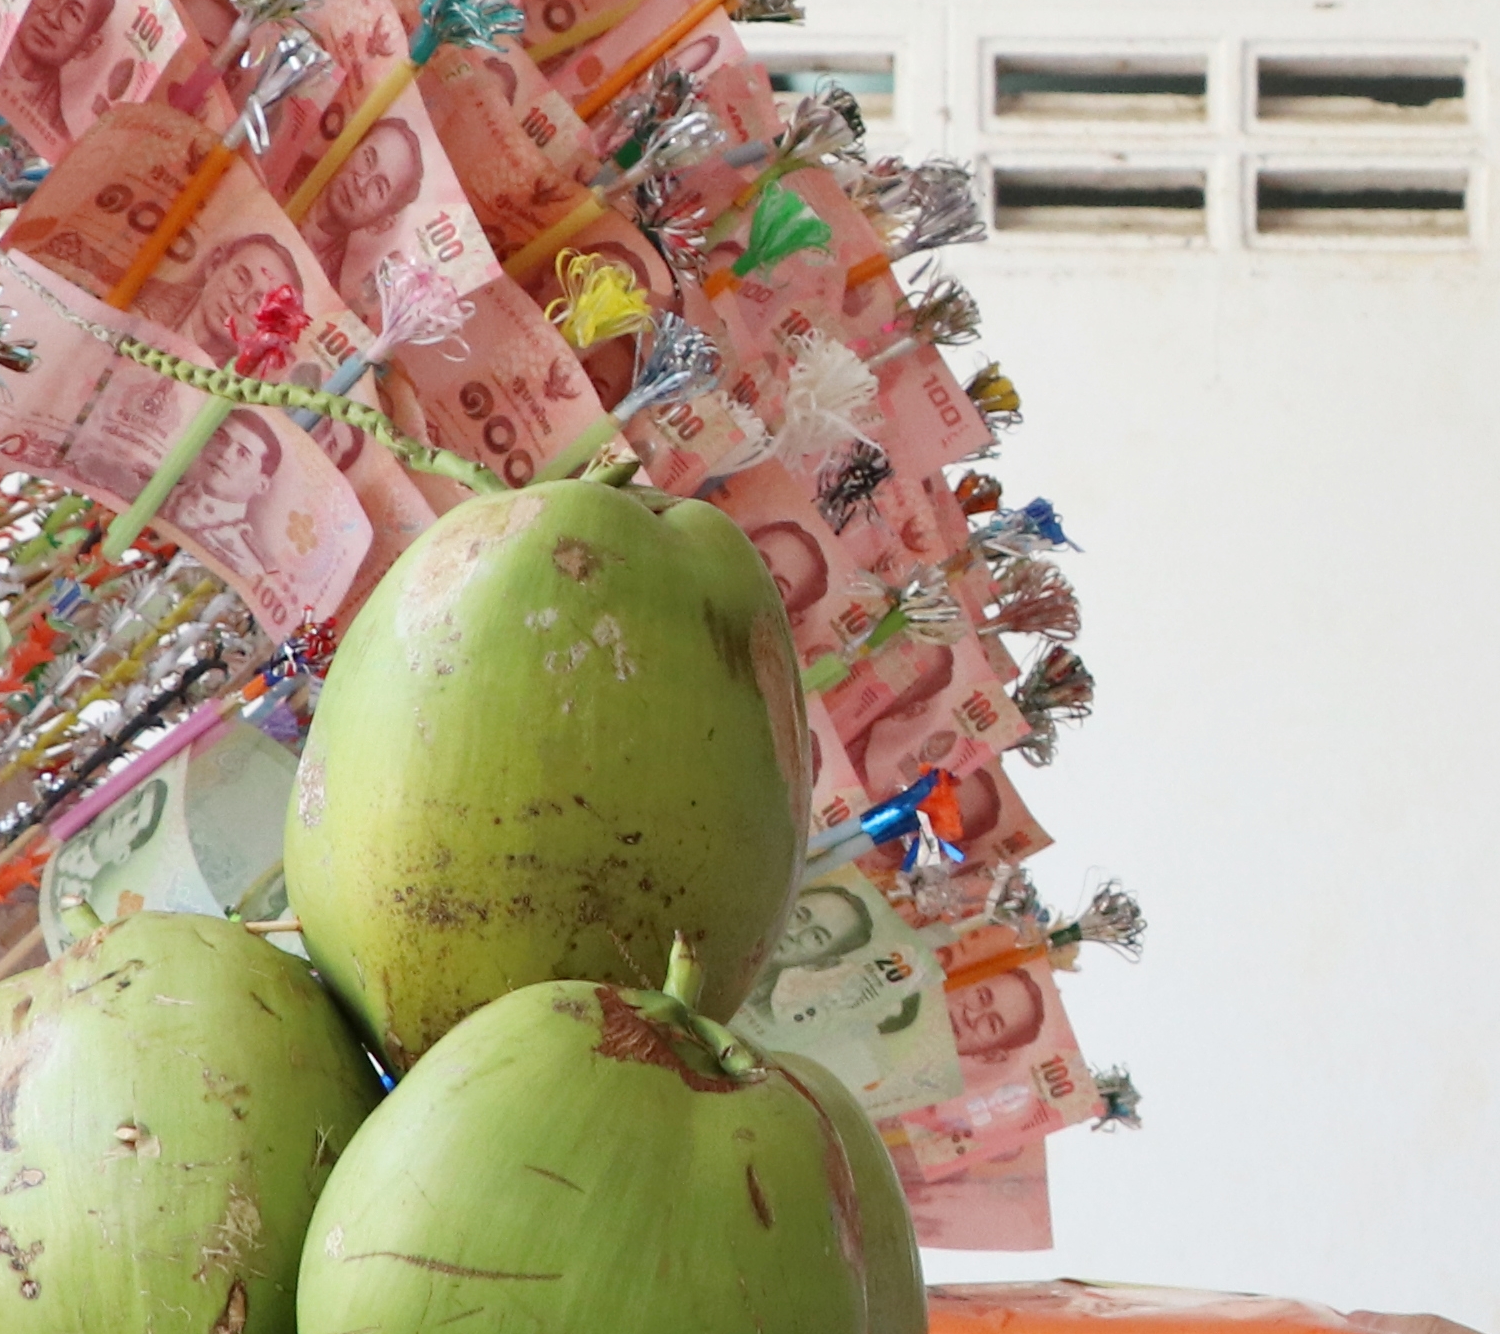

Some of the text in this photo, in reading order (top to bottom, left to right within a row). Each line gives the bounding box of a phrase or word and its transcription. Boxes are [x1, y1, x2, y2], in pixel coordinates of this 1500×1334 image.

[133, 4, 165, 53] 100
[521, 105, 557, 149] 100
[425, 210, 465, 264] 100
[920, 373, 963, 427] 100
[458, 380, 535, 489] ๑๐๐
[250, 573, 289, 626] 100
[962, 689, 1000, 734] 100
[874, 951, 913, 985] 20
[1038, 1054, 1076, 1098] 100
